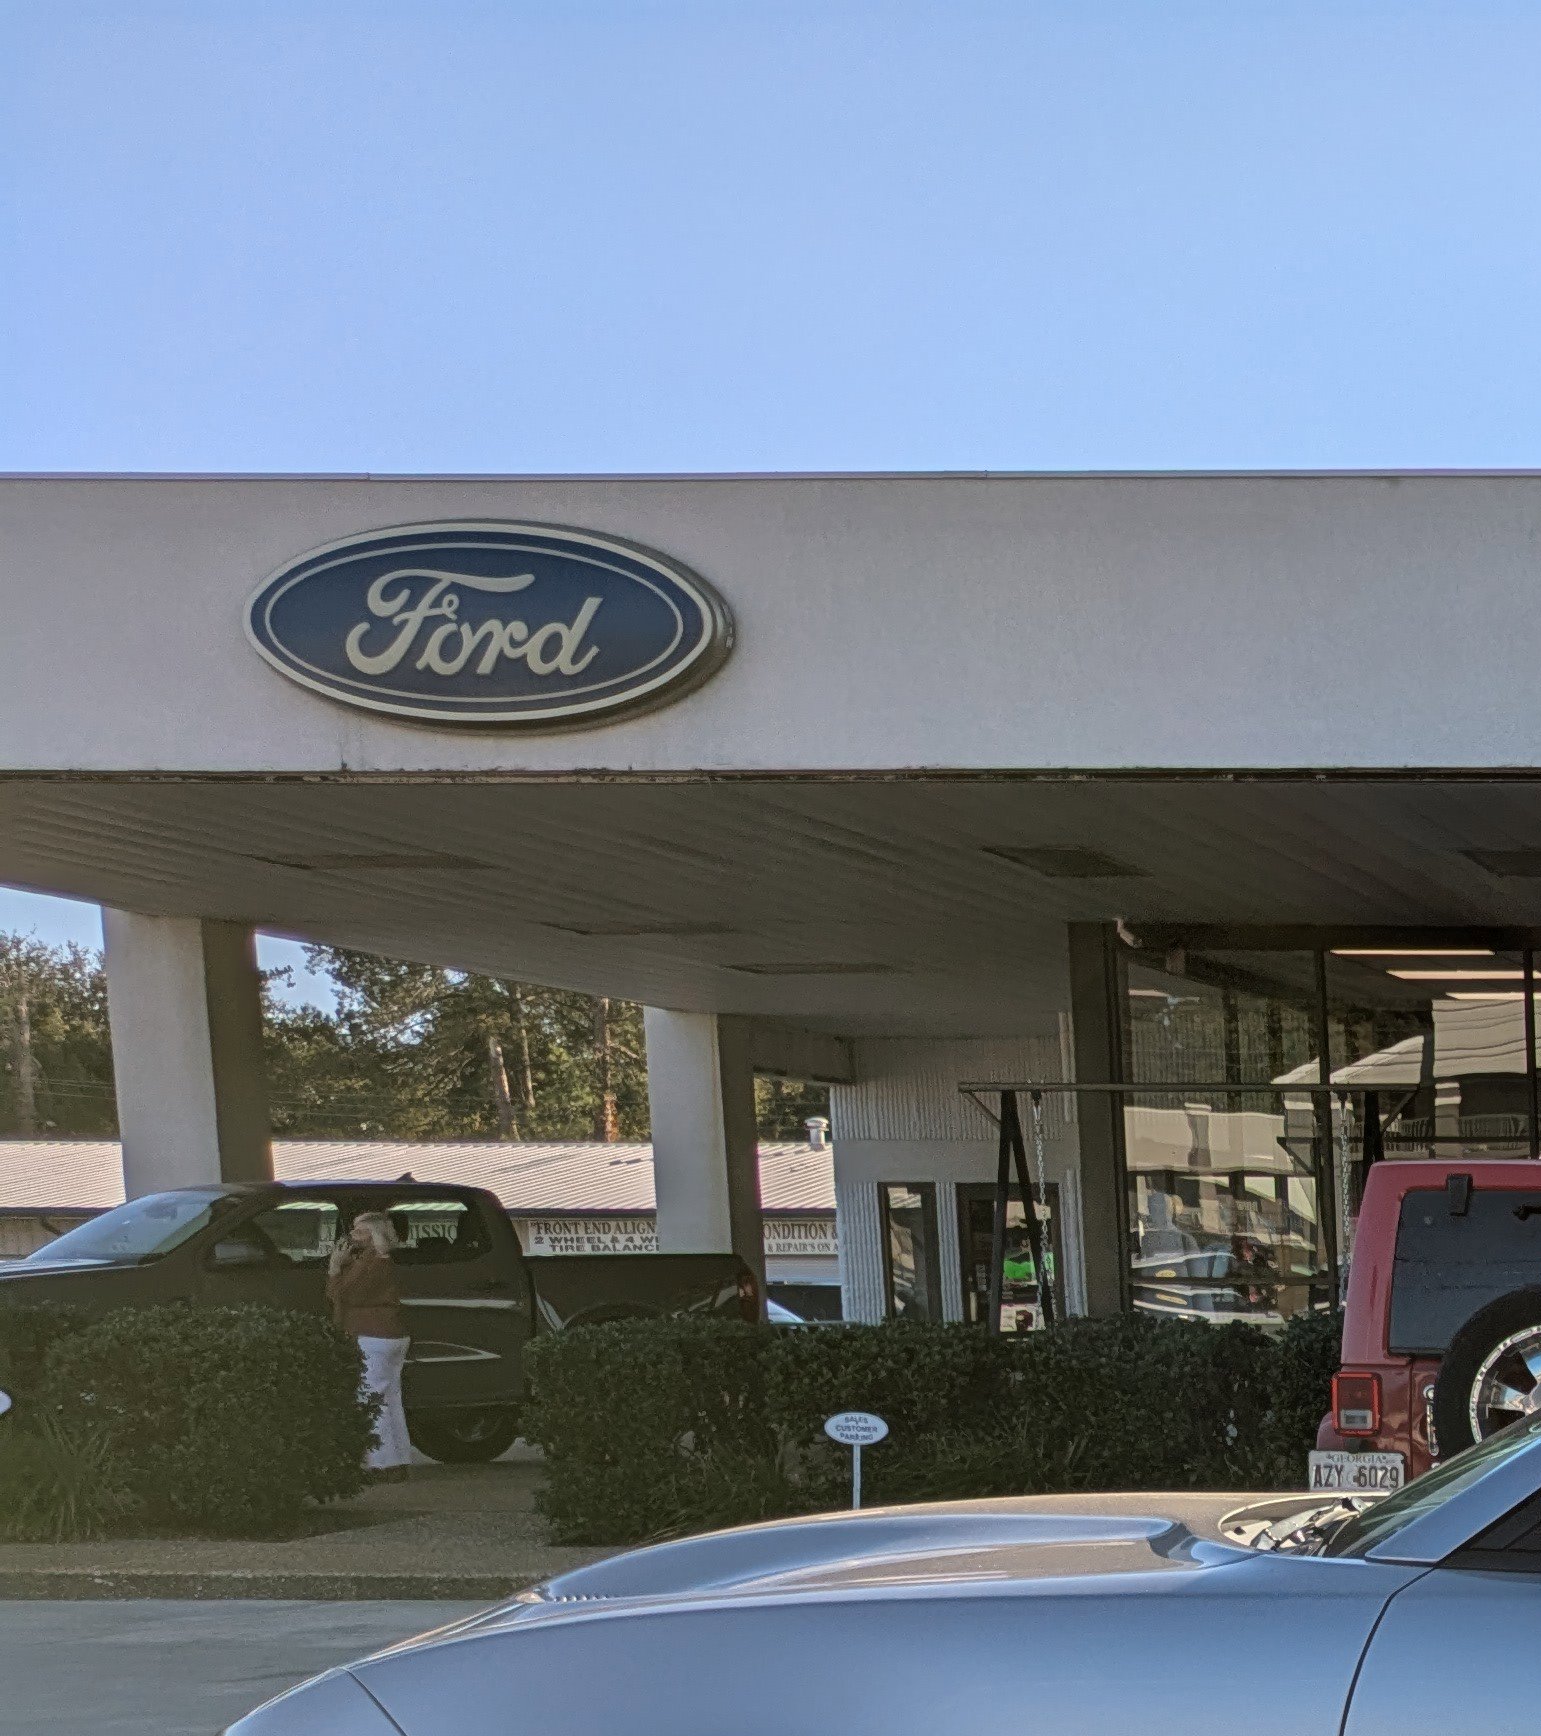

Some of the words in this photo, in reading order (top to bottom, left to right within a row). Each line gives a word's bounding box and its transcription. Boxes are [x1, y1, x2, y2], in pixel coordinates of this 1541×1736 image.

[345, 568, 604, 676] Ford
[584, 1221, 611, 1235] END
[534, 1236, 544, 1245] 2
[549, 1236, 605, 1245] WHEEL
[625, 1236, 635, 1244] 4
[549, 1244, 585, 1253] TIRE
[835, 1424, 878, 1432] CUSTOMER
[1333, 1454, 1383, 1463] GEORGIA
[1314, 1464, 1344, 1488] AZY
[1357, 1465, 1399, 1488] 6029
